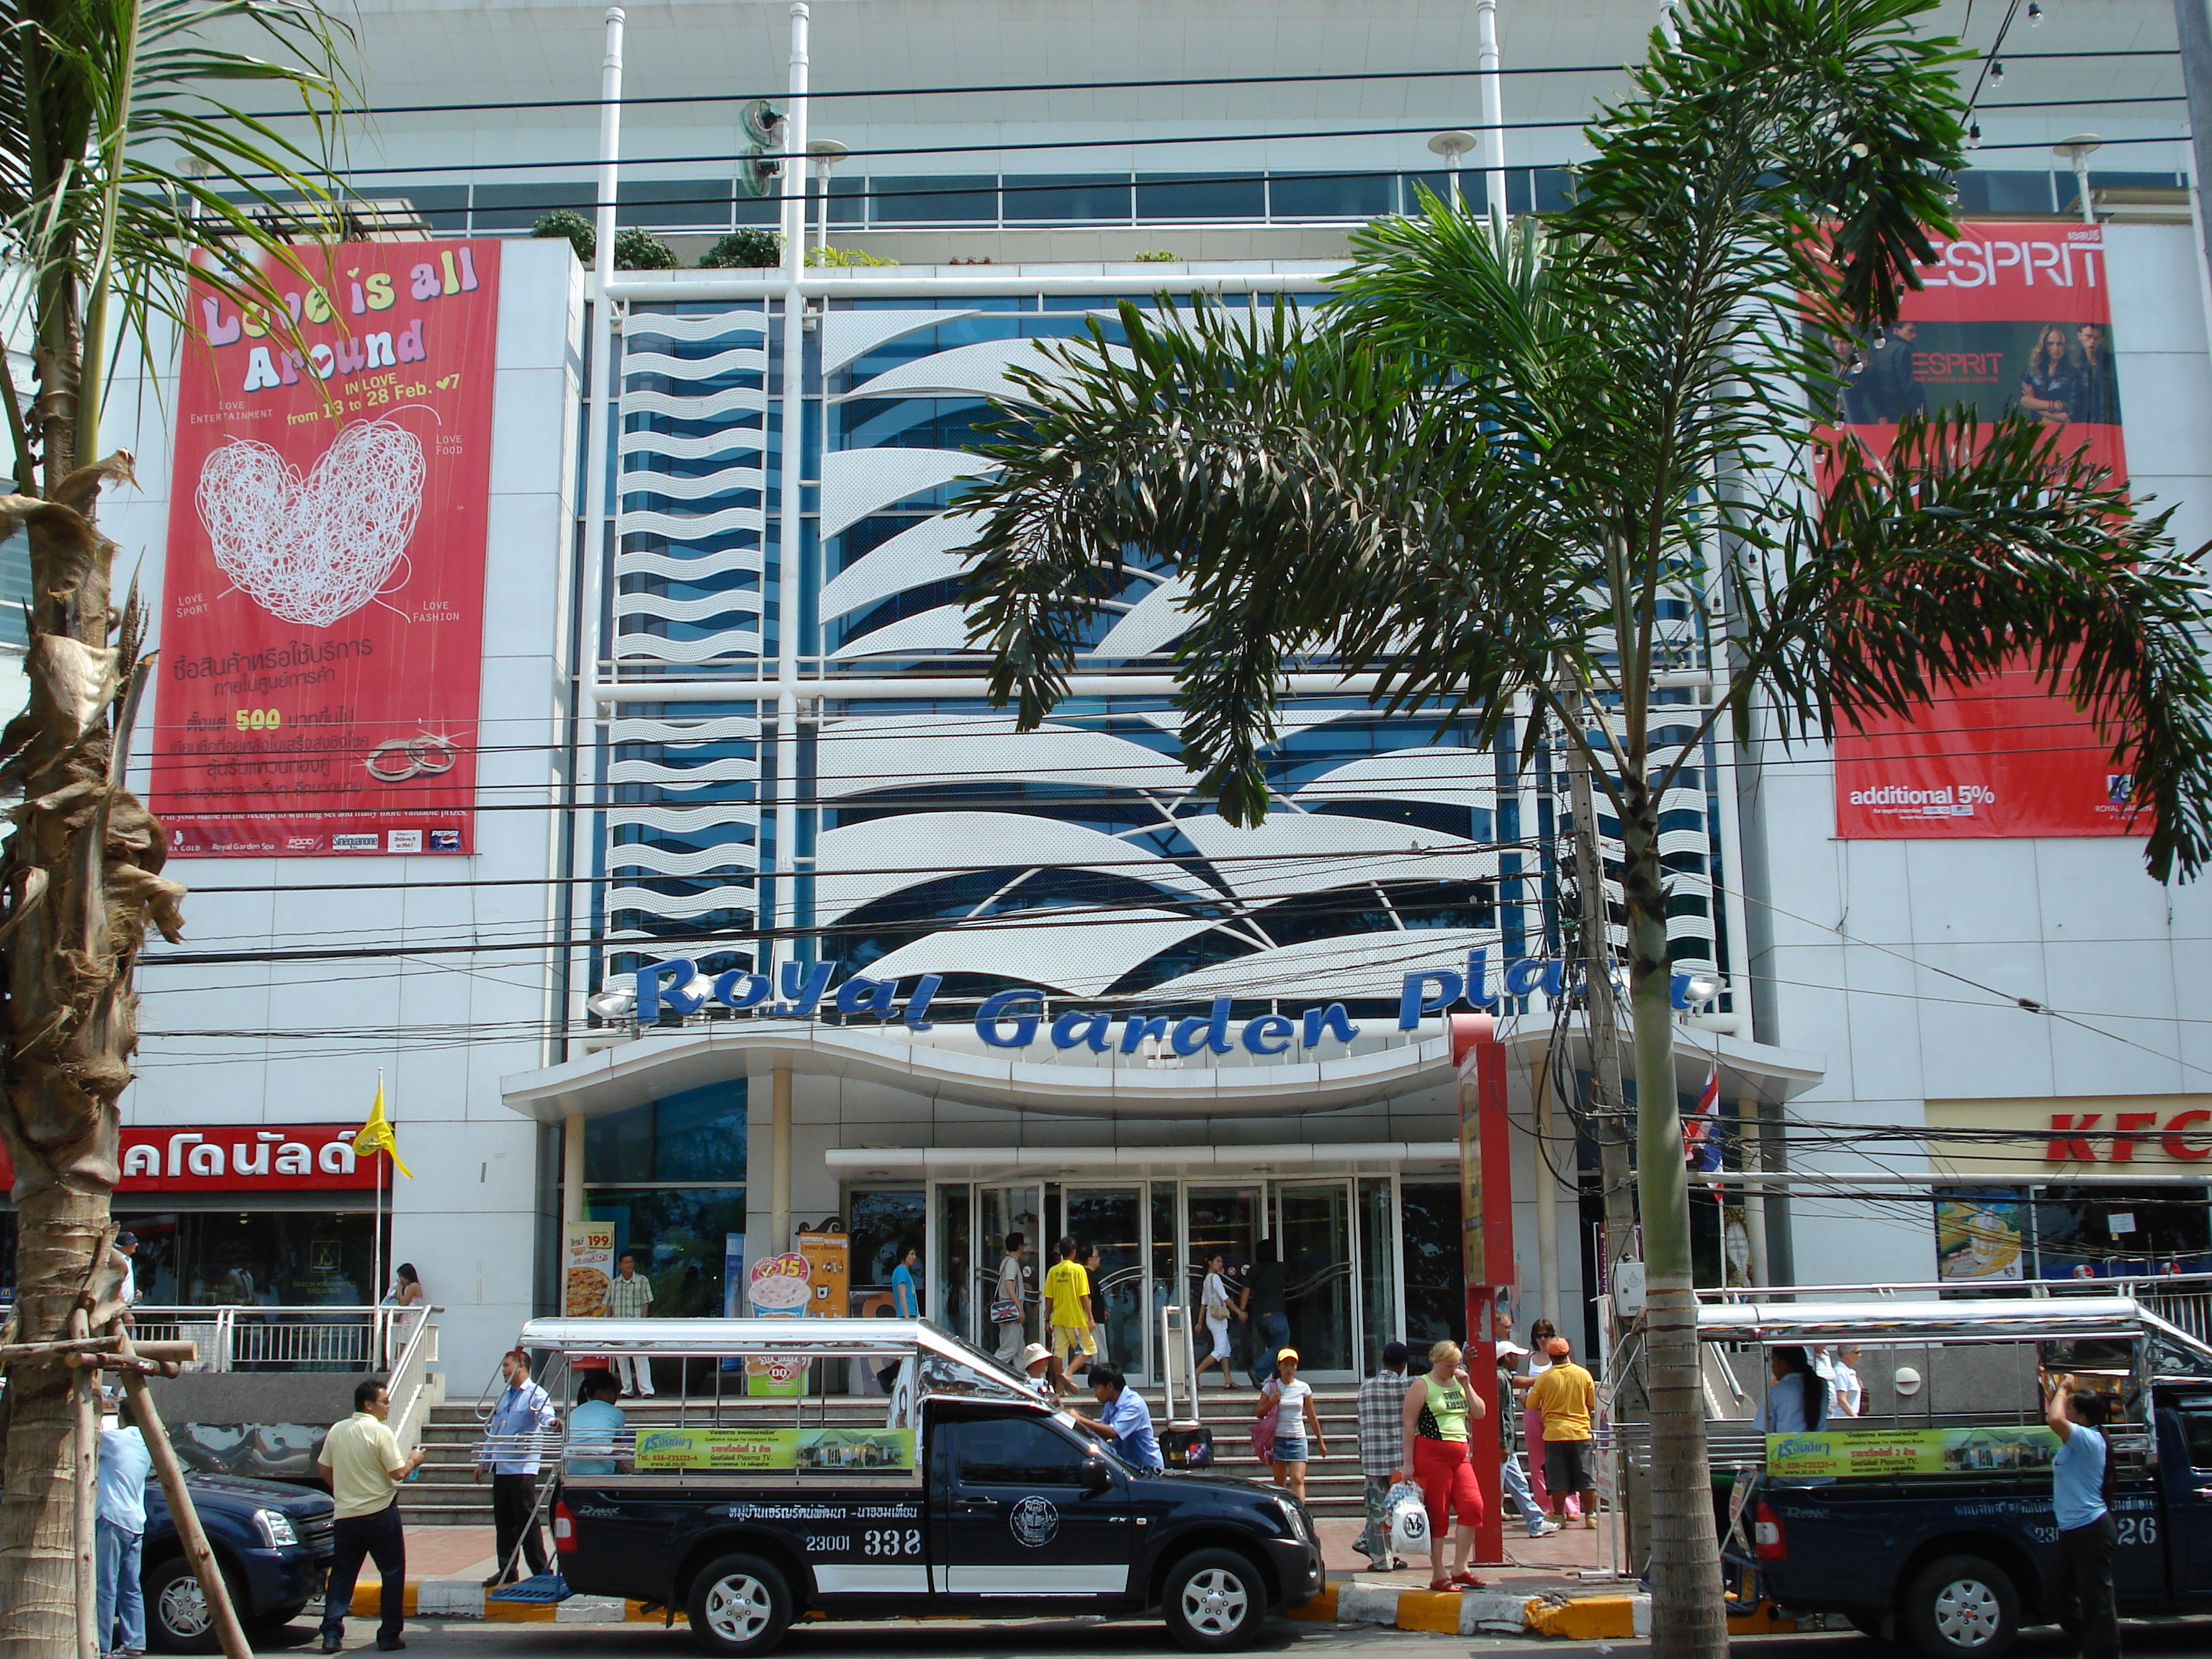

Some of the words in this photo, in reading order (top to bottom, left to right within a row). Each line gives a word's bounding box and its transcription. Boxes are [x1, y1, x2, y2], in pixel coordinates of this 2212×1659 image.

[1912, 241, 2104, 287] ESPRIT
[202, 284, 333, 347] Love
[347, 267, 396, 314] is
[410, 246, 479, 300] all
[243, 319, 426, 392] Around
[1911, 353, 2002, 374] ESPRIT
[345, 381, 358, 395] IN
[362, 372, 397, 391] LOVE
[219, 400, 243, 410] LOVE
[287, 410, 318, 425] from
[324, 401, 344, 418] 13
[349, 400, 361, 411] to
[367, 387, 389, 405] 28
[395, 385, 432, 401] Feb.
[190, 410, 273, 424] ENTERTAINMENT
[436, 435, 462, 444] LOVE
[436, 445, 462, 455] FOOD
[179, 593, 204, 606] LOVE
[423, 601, 449, 611] LOVE
[176, 604, 208, 618] SPORT
[413, 612, 460, 623] FASHION
[173, 639, 372, 680] ซื้อสินค้าหรือใช้บริการ
[236, 709, 281, 731] 500
[1851, 786, 1954, 804] additional
[1959, 786, 1995, 804] 5%
[637, 958, 943, 1033] Royal
[975, 989, 1359, 1056] Garden
[2044, 1110, 2212, 1161] KFC
[123, 1130, 357, 1177] คโดนัลด์
[771, 1368, 787, 1378] DQ
[806, 1534, 850, 1550] 23001
[864, 1529, 921, 1556] 338
